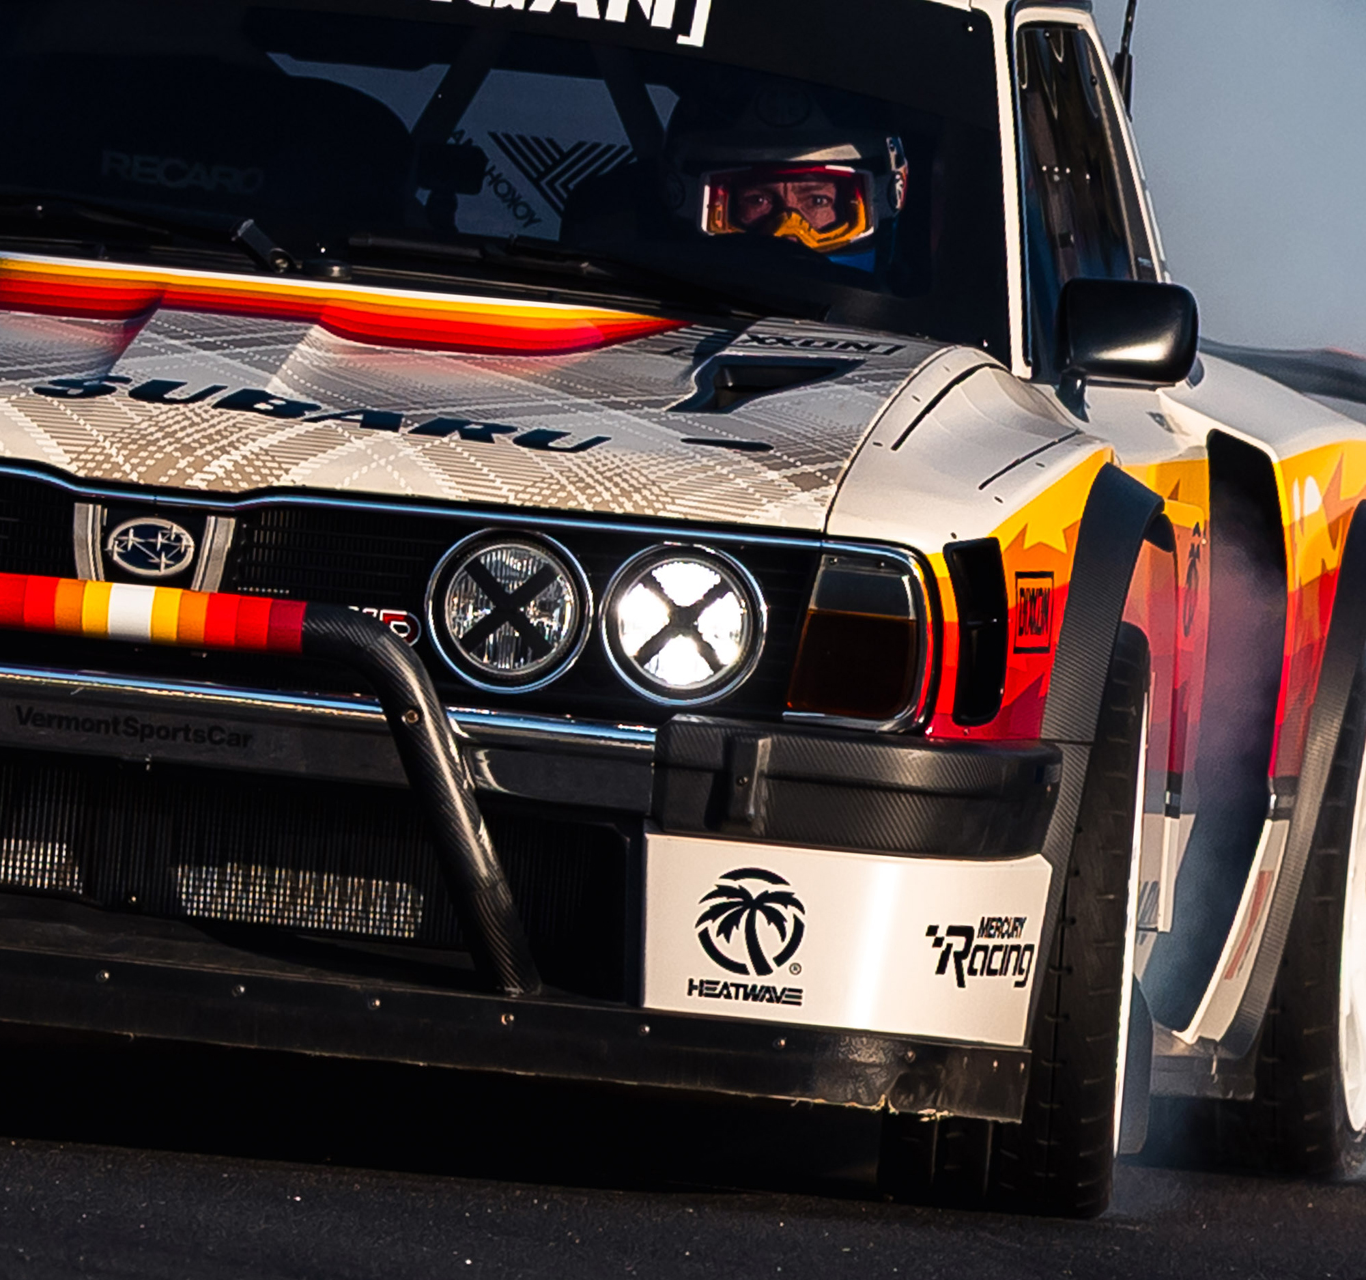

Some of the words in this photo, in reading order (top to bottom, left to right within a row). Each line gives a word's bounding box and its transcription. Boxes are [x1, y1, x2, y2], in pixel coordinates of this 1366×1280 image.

[101, 148, 264, 195] RECARO
[34, 375, 611, 453] SUBARU
[977, 916, 1027, 939] MERCURY
[933, 925, 1035, 988] Racing
[687, 978, 803, 1006] HEATWAVE
